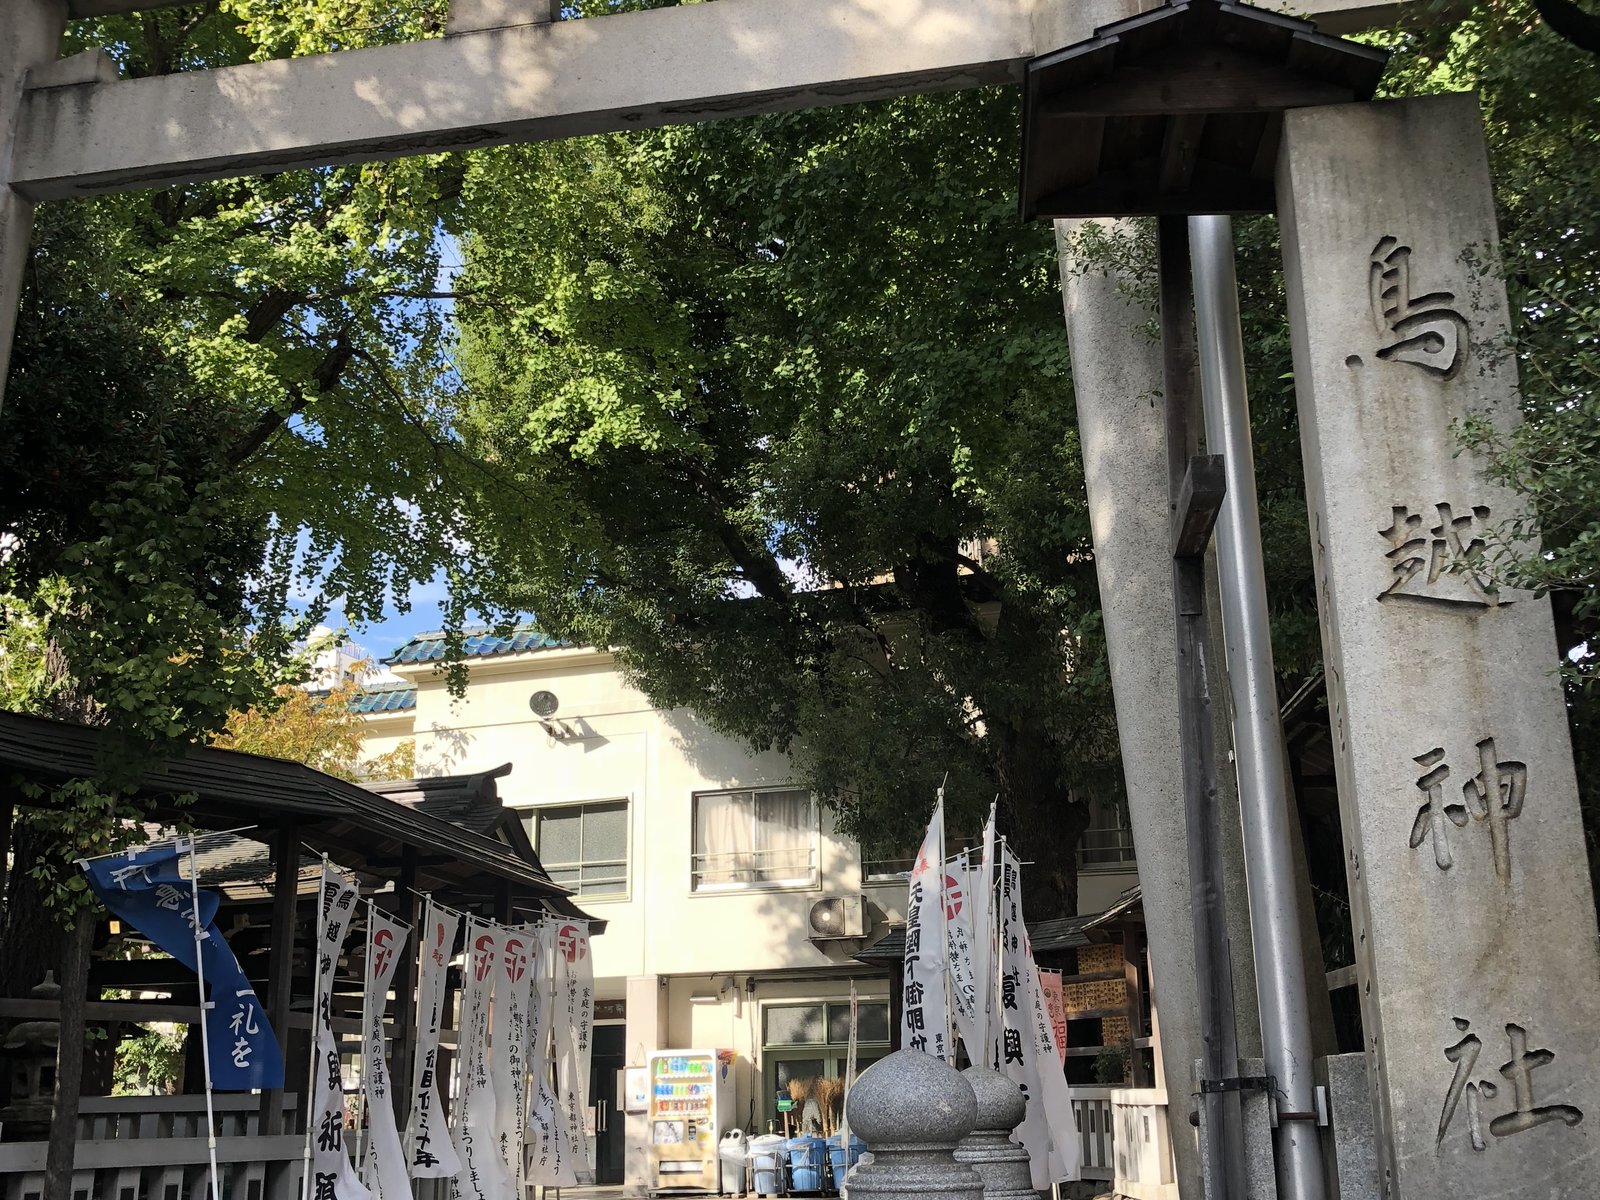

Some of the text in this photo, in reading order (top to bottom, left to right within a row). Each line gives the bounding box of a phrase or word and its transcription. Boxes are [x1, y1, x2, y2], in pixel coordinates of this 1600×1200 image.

[1345, 236, 1583, 1157] 鳥越神社
[579, 987, 591, 1052] 家庭の守護神
